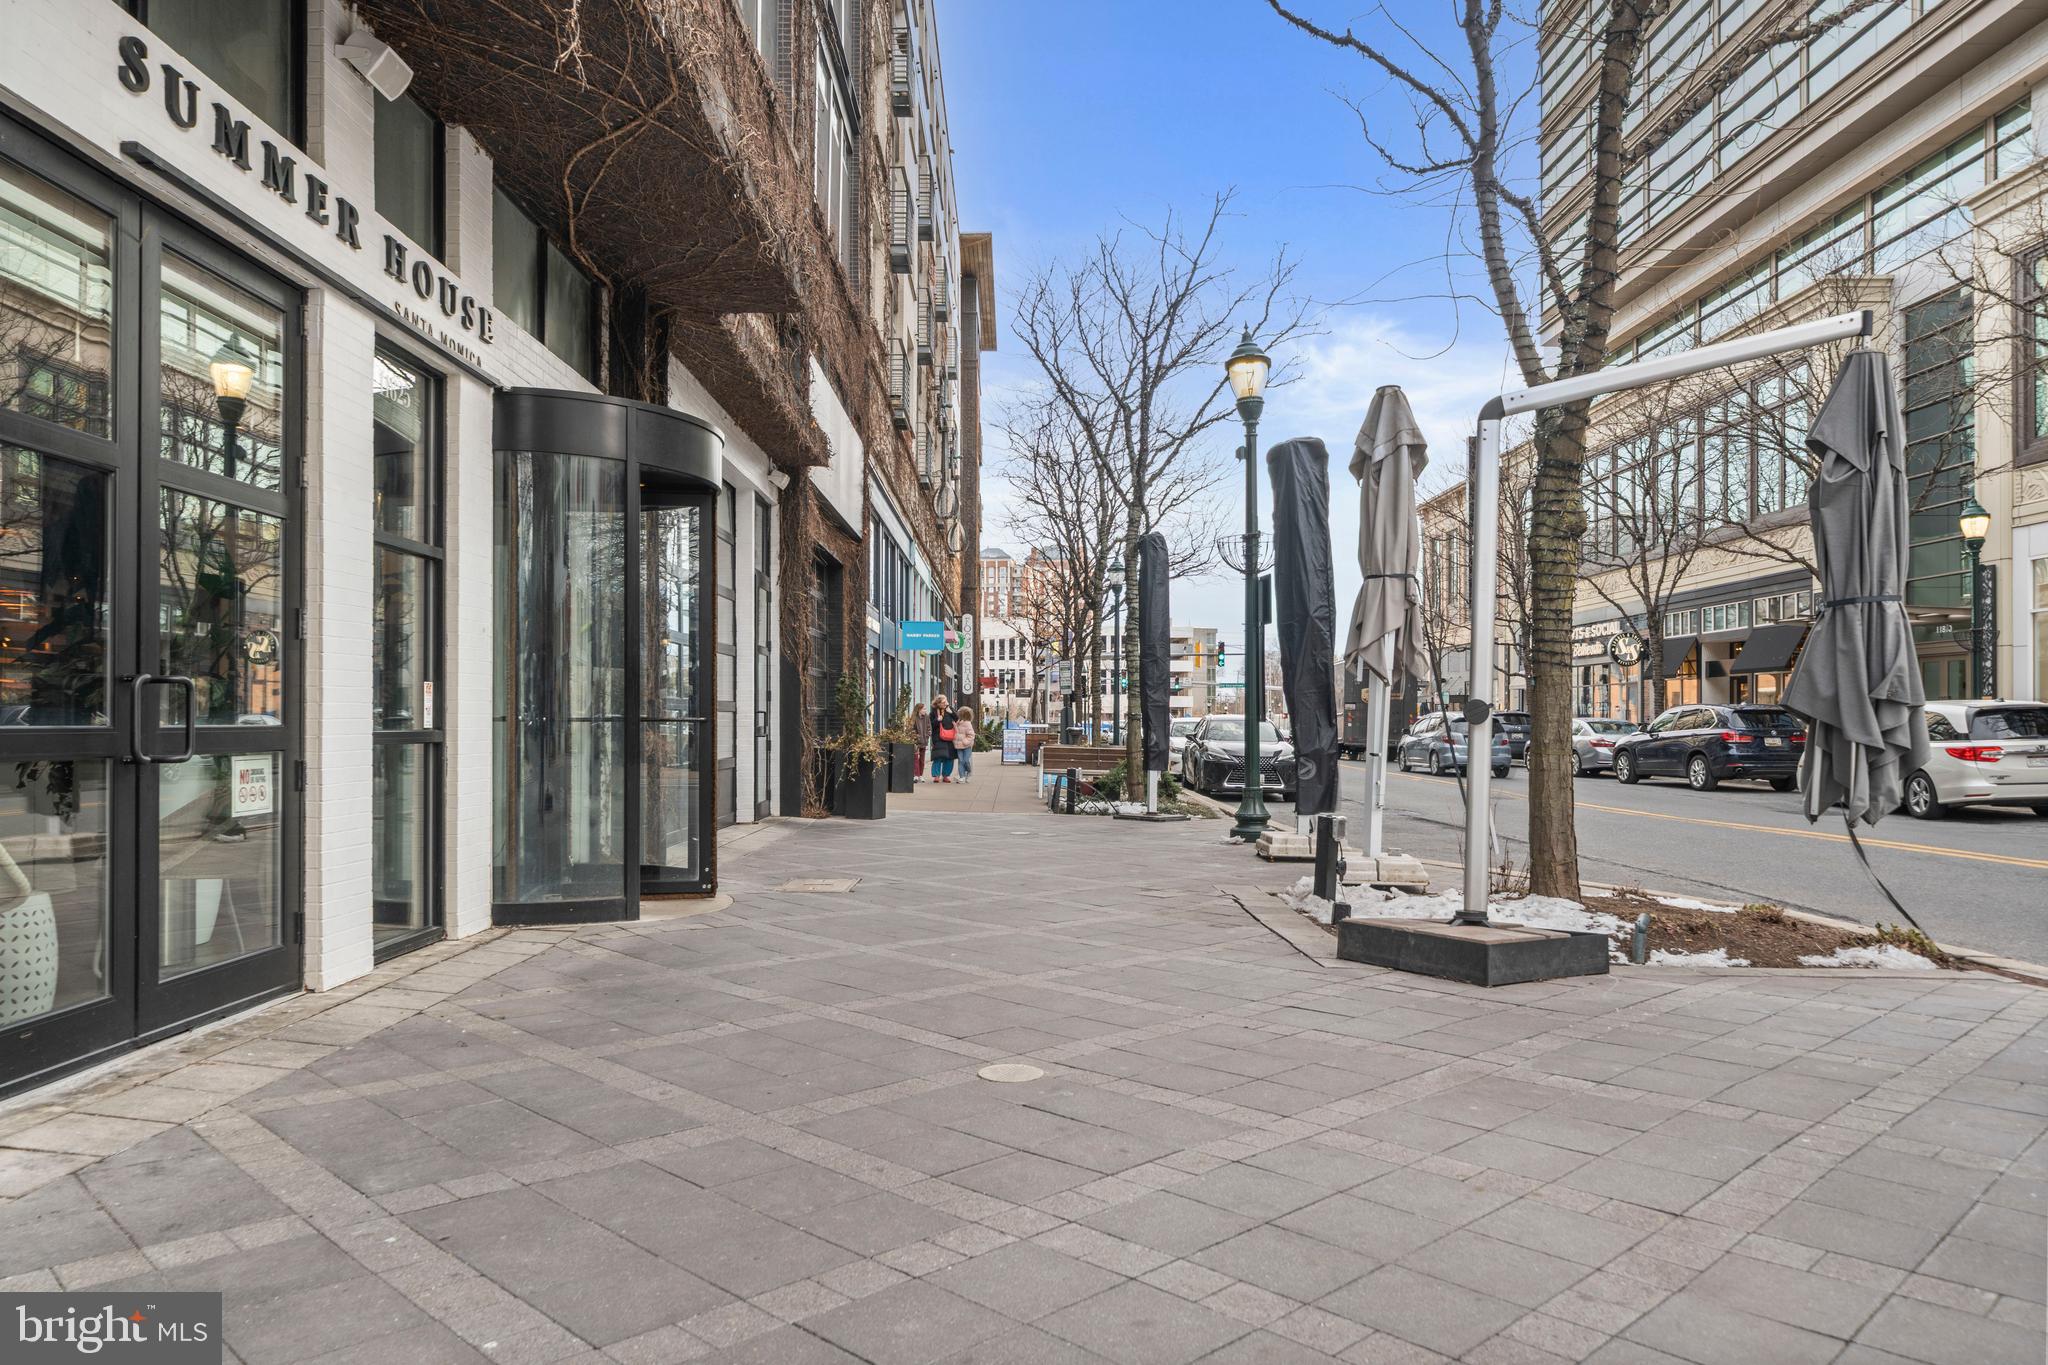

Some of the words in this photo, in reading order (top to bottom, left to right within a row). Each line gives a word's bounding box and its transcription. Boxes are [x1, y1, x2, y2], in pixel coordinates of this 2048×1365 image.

[118, 36, 362, 250] SUMMER
[384, 234, 494, 344] HOUSE
[394, 301, 433, 337] SANTA
[441, 331, 482, 369] MONICA
[1591, 621, 1621, 637] SOCIAL
[240, 769, 250, 785] NO
